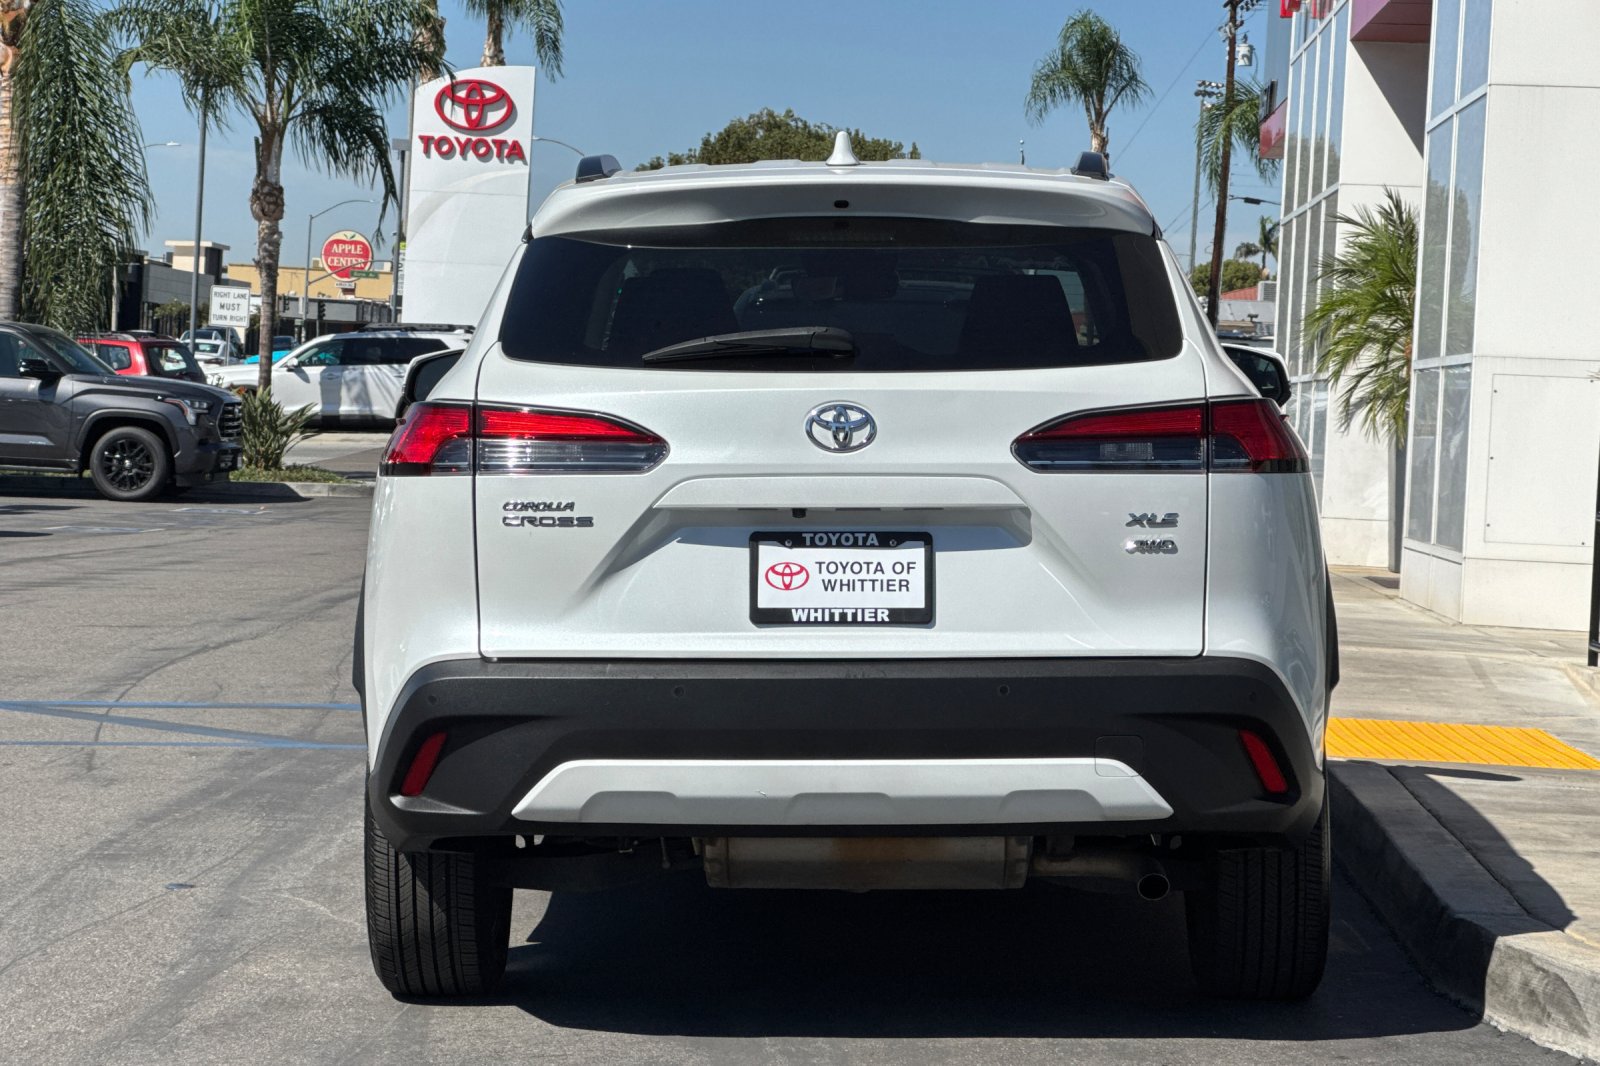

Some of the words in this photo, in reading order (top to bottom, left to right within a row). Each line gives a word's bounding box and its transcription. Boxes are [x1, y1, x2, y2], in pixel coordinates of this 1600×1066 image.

[417, 134, 525, 161] TOYOTA
[331, 243, 363, 254] APPLE
[327, 256, 365, 268] CENTER
[213, 291, 231, 299] RIGHT
[233, 292, 248, 300] LANE
[219, 302, 241, 311] MUST
[502, 501, 575, 512] COROLLA
[502, 516, 594, 528] CROSS
[1125, 512, 1179, 529] XLE
[802, 533, 879, 546] TOYOTA
[815, 561, 885, 575] TOYOTA
[892, 561, 917, 575] OF
[822, 579, 910, 592] WHITTIER
[791, 608, 890, 622] WHITTIER
